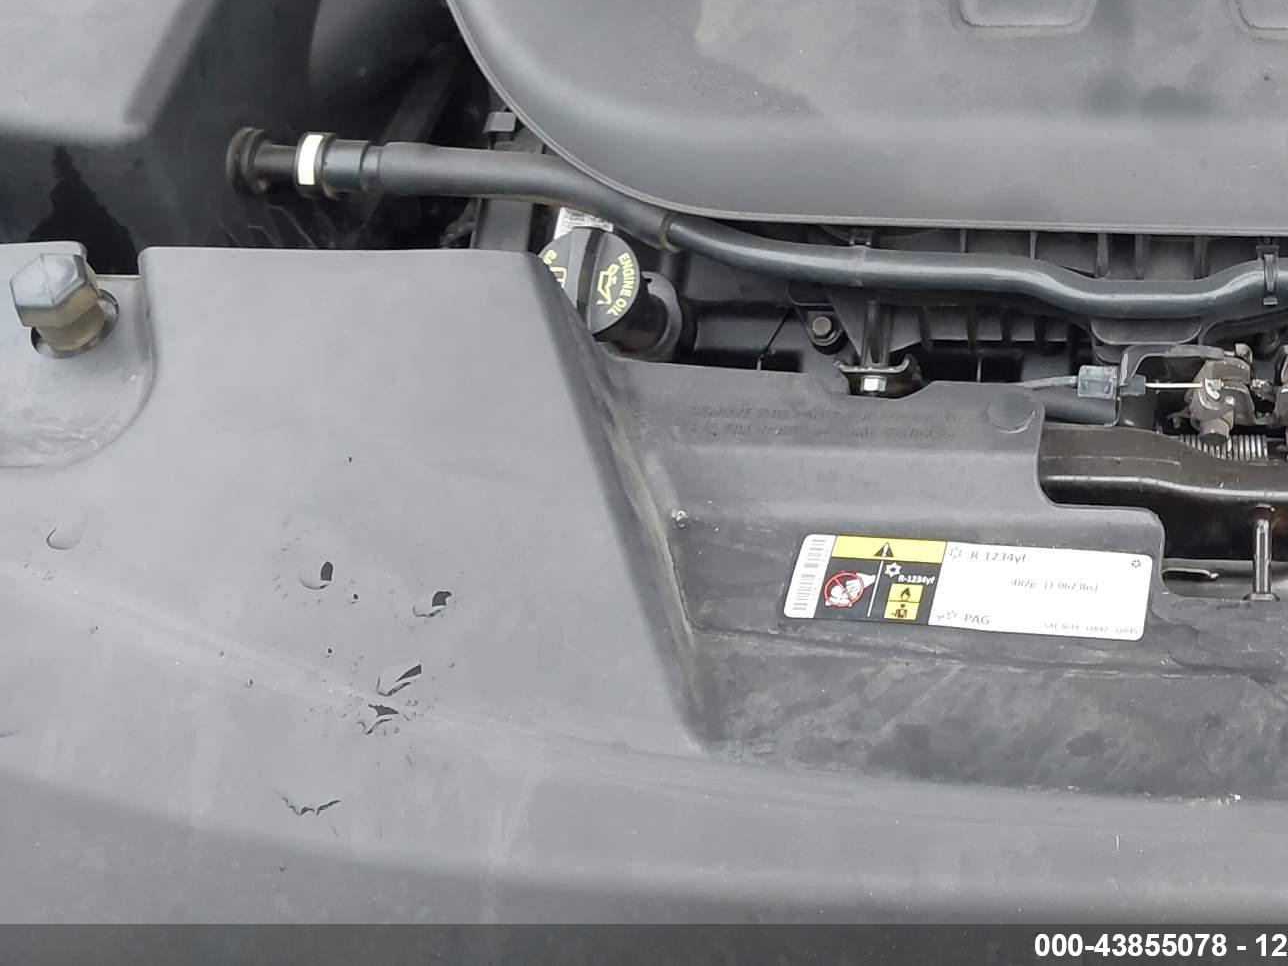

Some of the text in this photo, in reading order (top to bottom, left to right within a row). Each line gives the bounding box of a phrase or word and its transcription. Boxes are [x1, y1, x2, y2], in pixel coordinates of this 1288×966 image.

[606, 252, 636, 316] ENGINE OIL
[898, 574, 936, 585] R-1234yf
[963, 613, 991, 626] PAG
